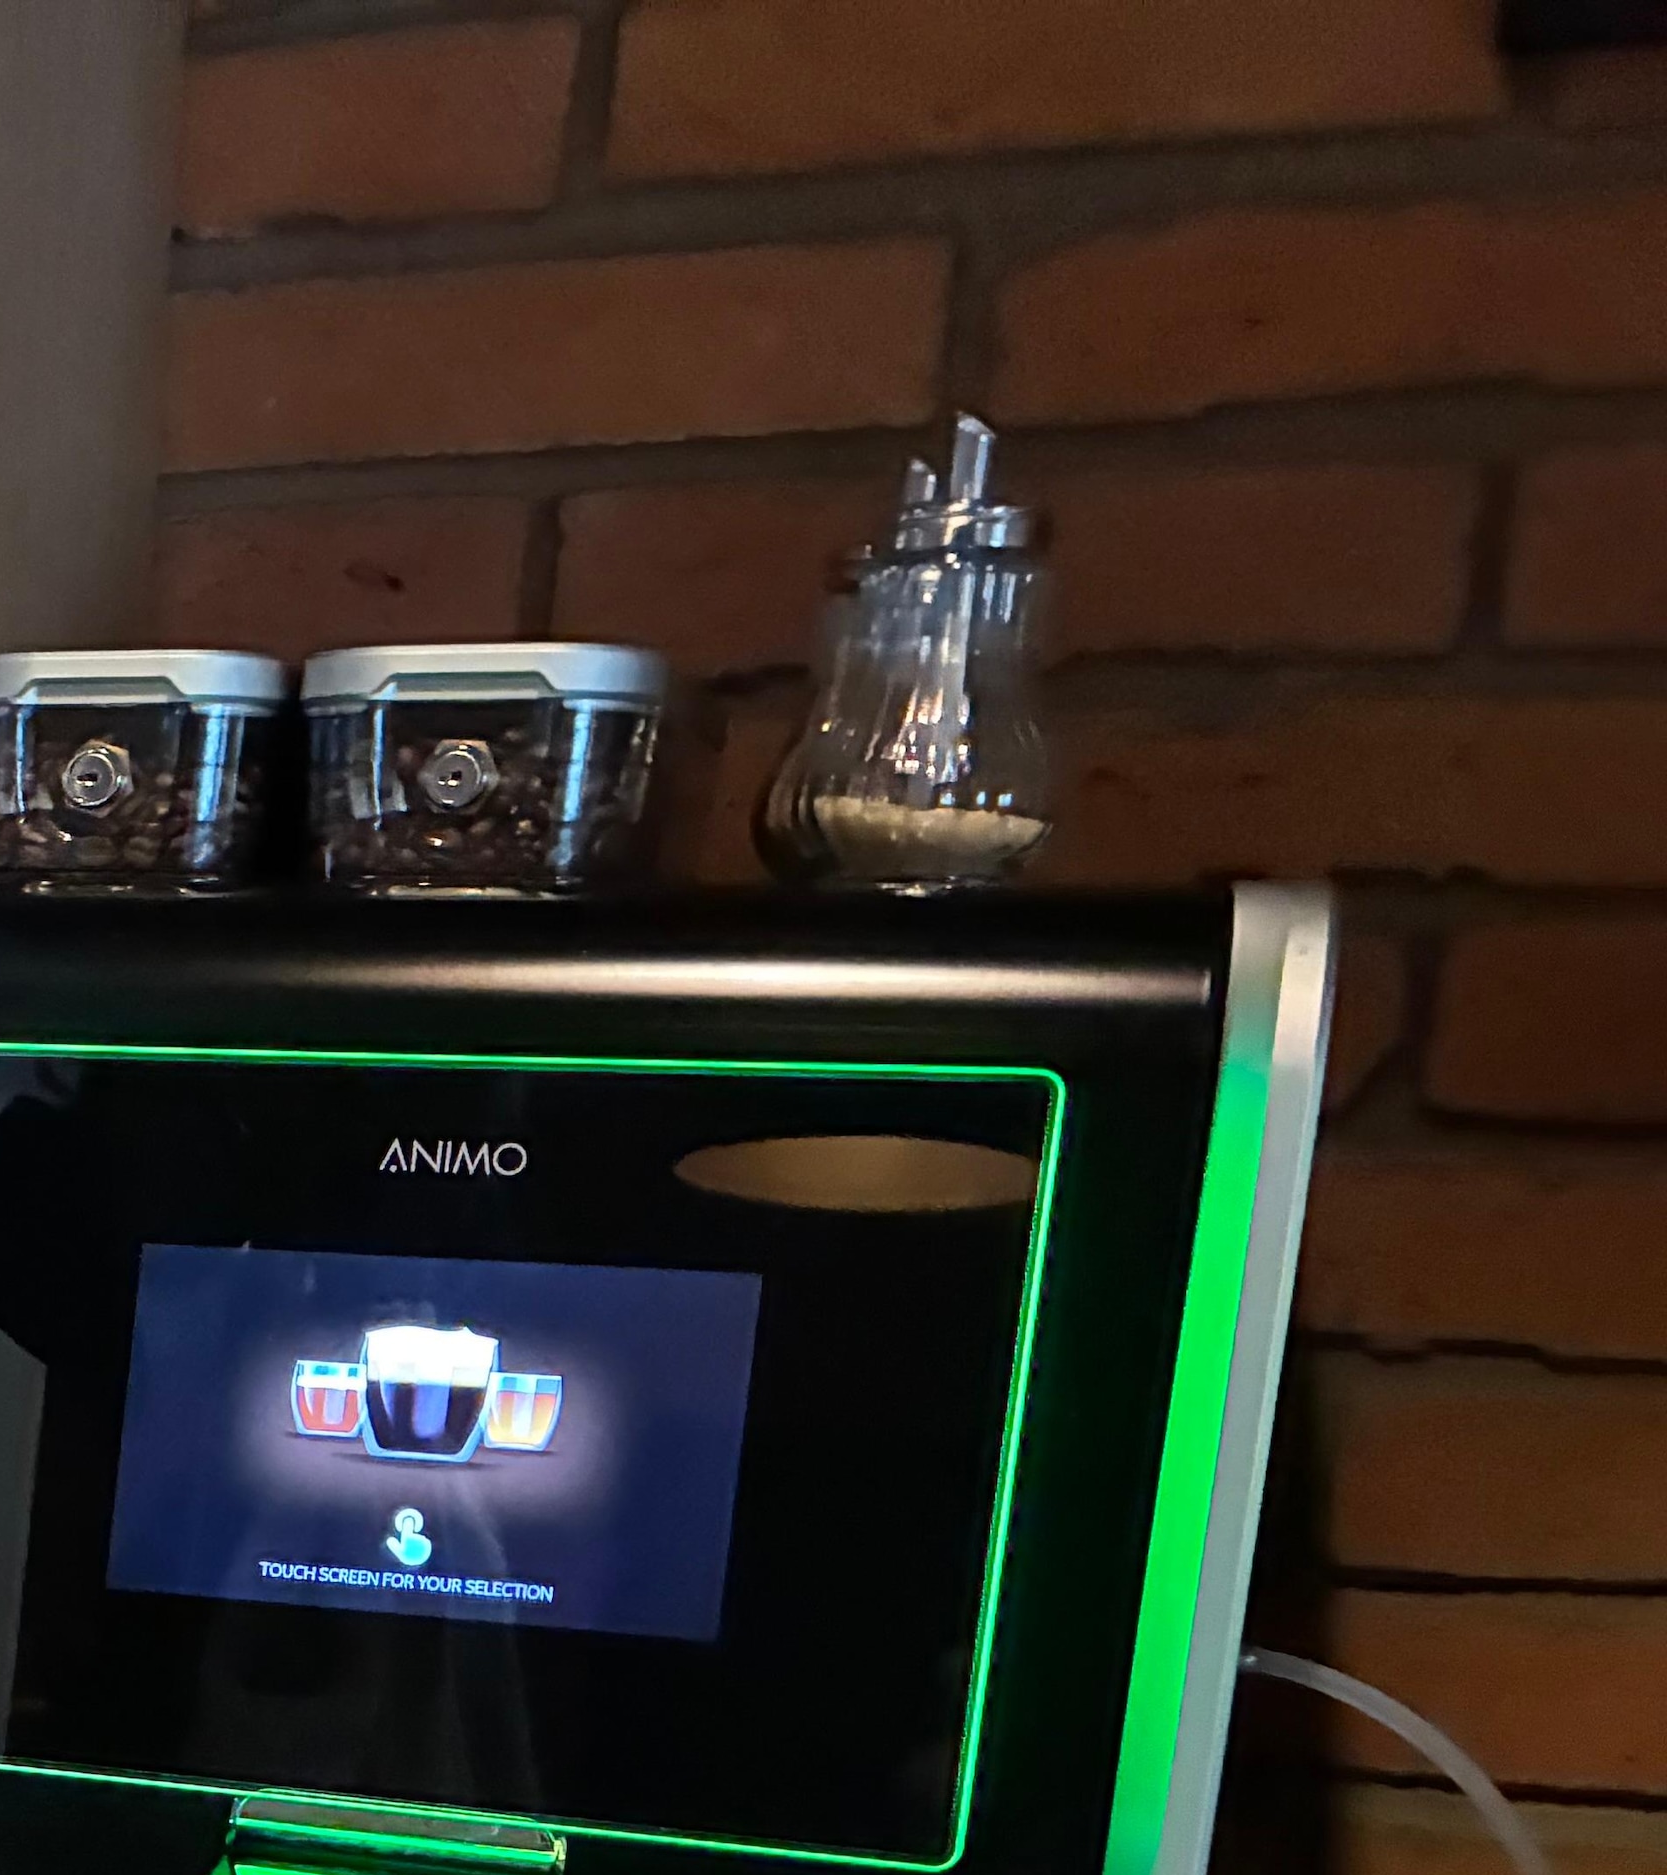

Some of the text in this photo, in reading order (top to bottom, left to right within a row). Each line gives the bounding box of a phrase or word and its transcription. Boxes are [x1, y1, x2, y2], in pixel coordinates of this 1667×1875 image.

[379, 1137, 528, 1176] ANIMO
[259, 1561, 555, 1603] TOUCH SCREEN FOR YOUR SELECTION
